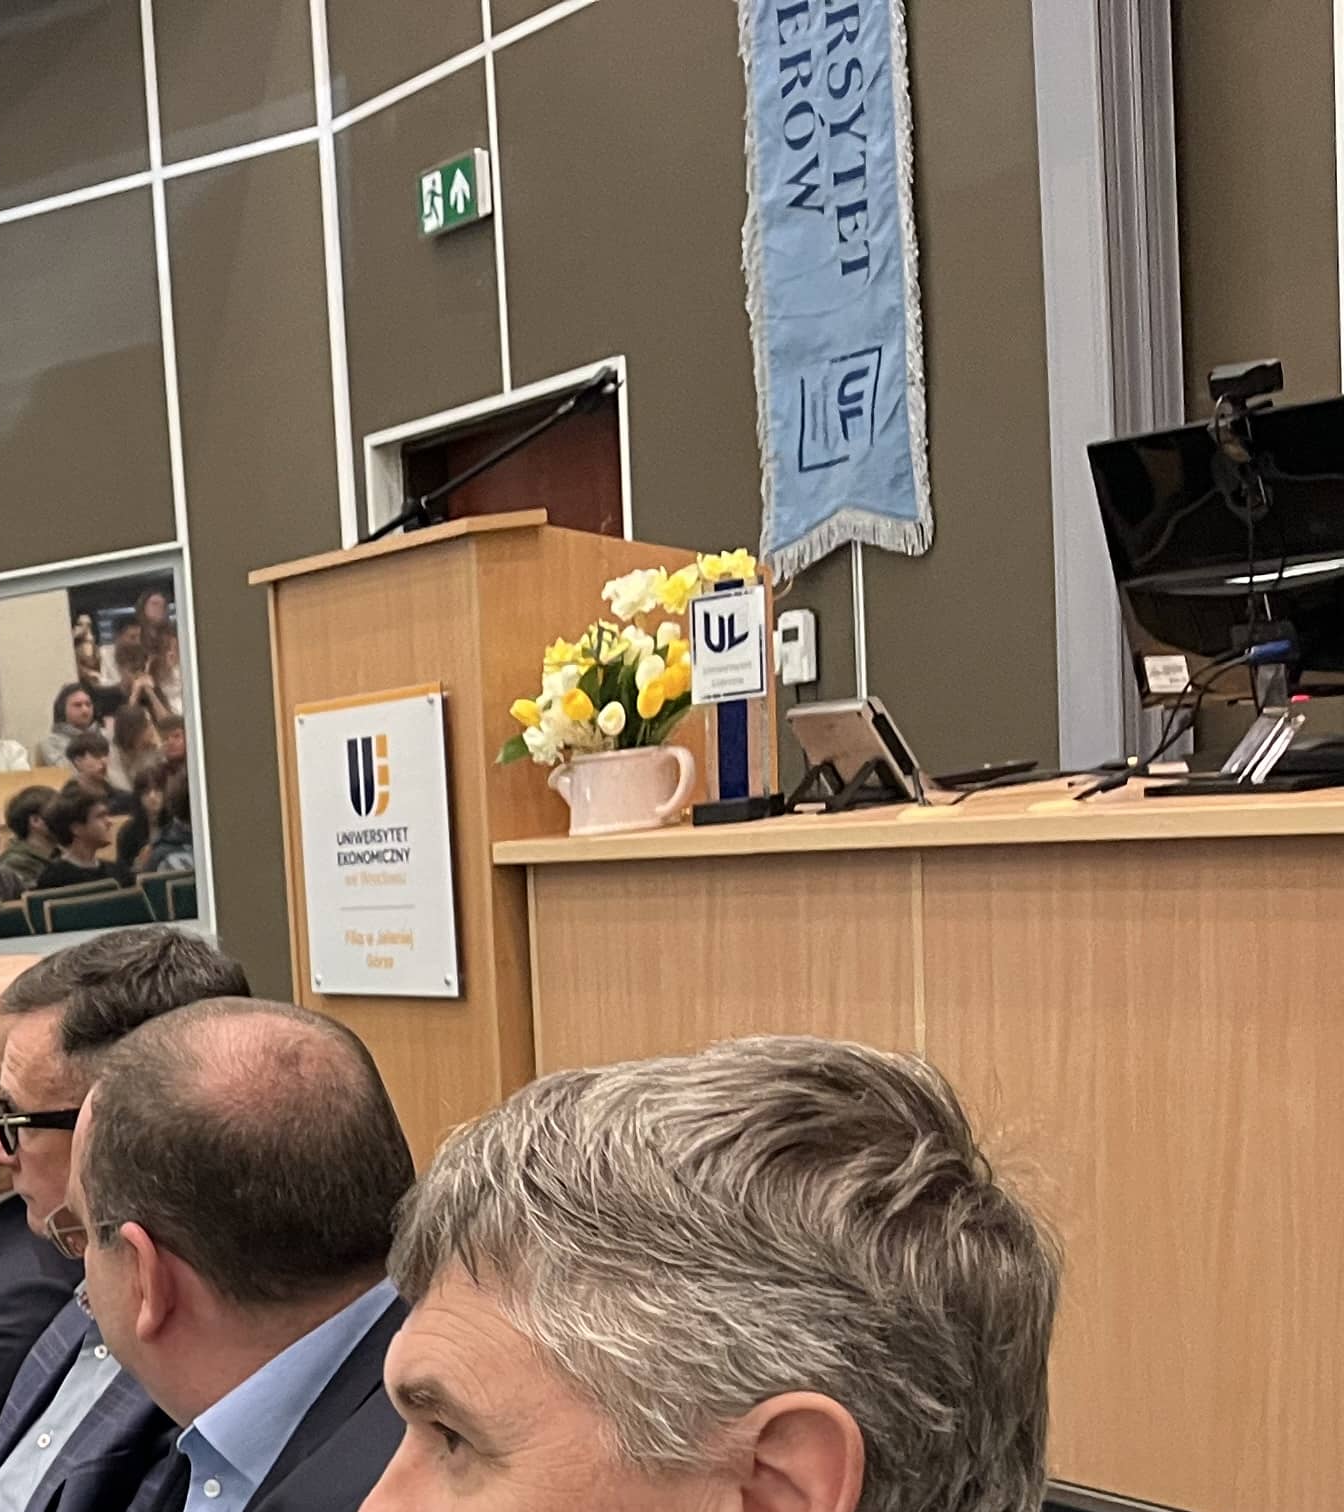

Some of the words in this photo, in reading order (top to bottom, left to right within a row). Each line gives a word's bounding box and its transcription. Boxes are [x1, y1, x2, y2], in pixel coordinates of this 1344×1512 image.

[825, 0, 870, 284] RSYTET
[703, 611, 749, 653] UL
[336, 827, 408, 846] UNIWERSYTET
[337, 848, 410, 866] EKONOMICZNY
